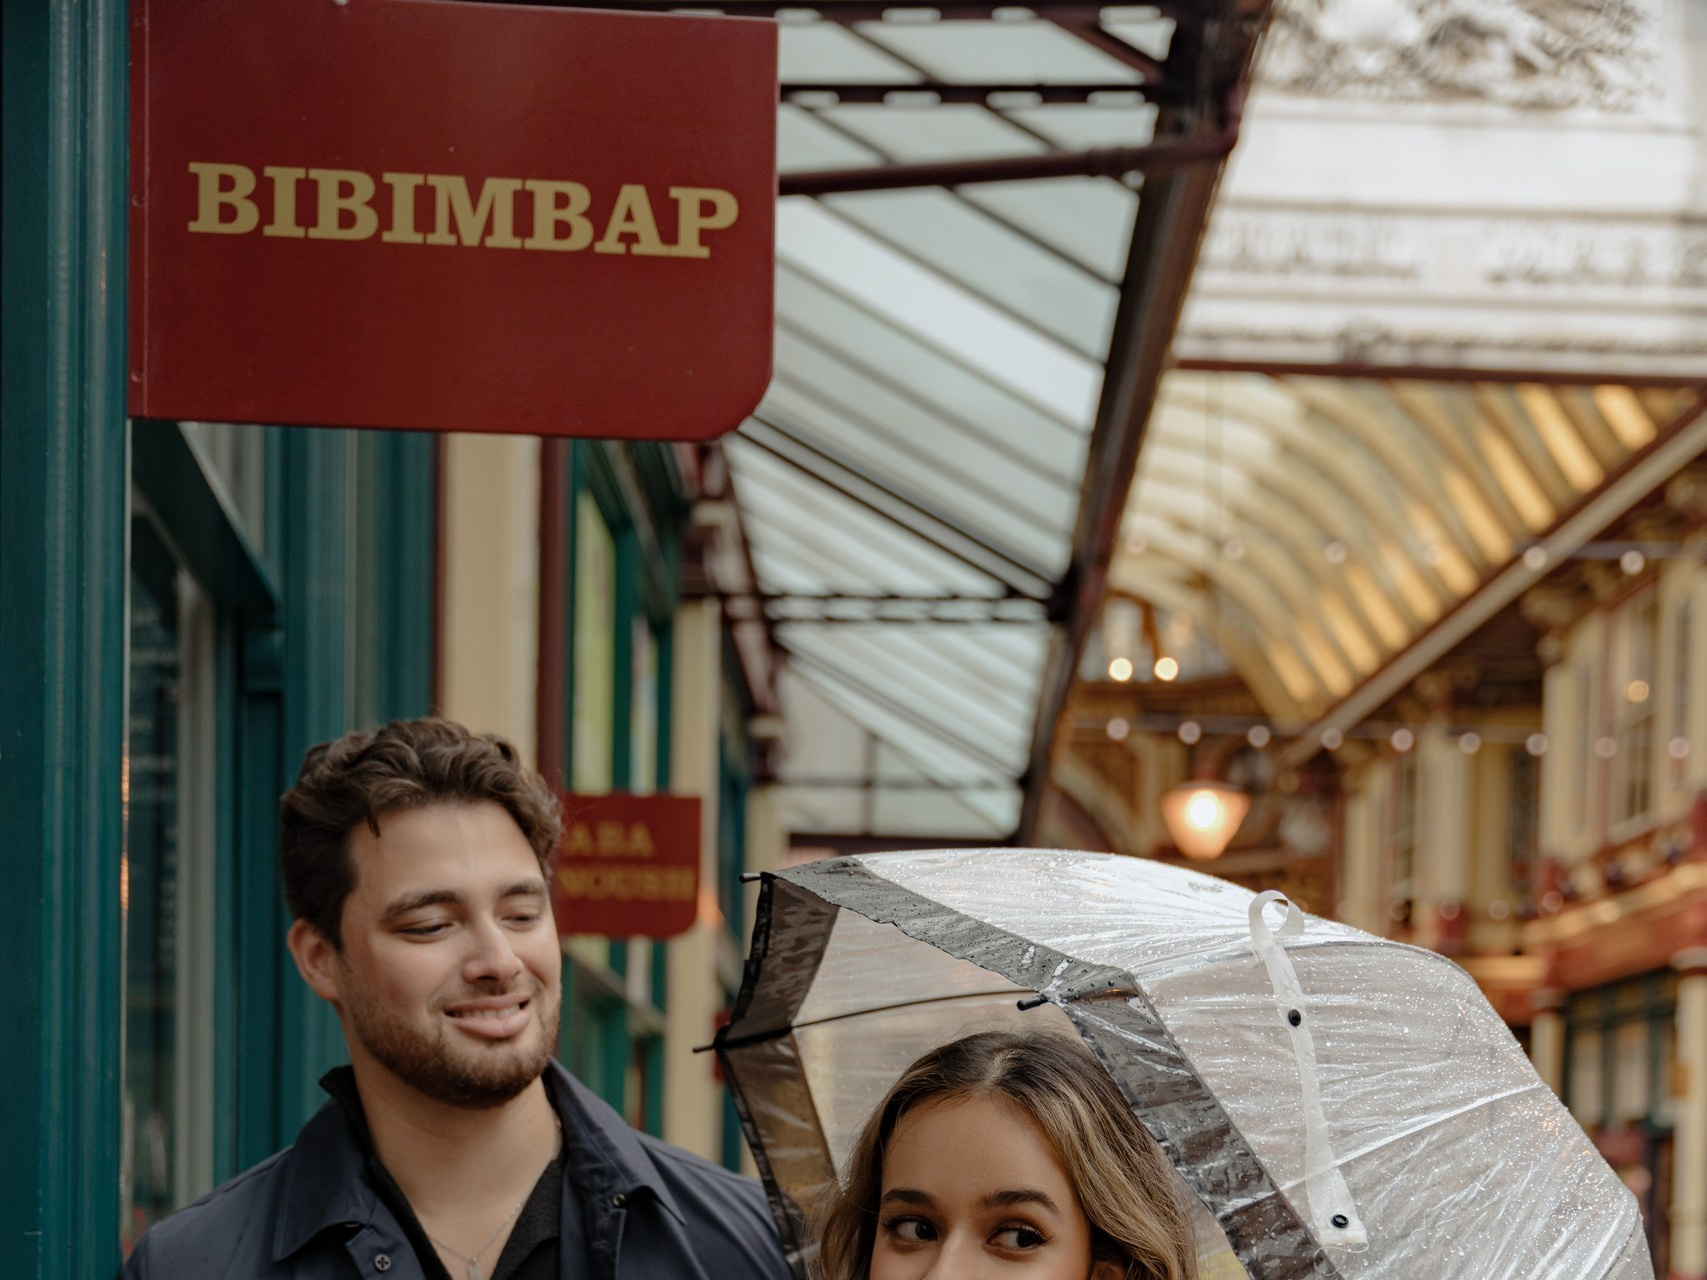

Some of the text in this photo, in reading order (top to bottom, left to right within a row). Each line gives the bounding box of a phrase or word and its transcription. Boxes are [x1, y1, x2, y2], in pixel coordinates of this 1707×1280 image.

[187, 161, 740, 259] BIBIMBAP
[564, 821, 654, 857] ABA
[557, 866, 694, 901] NOUSH
